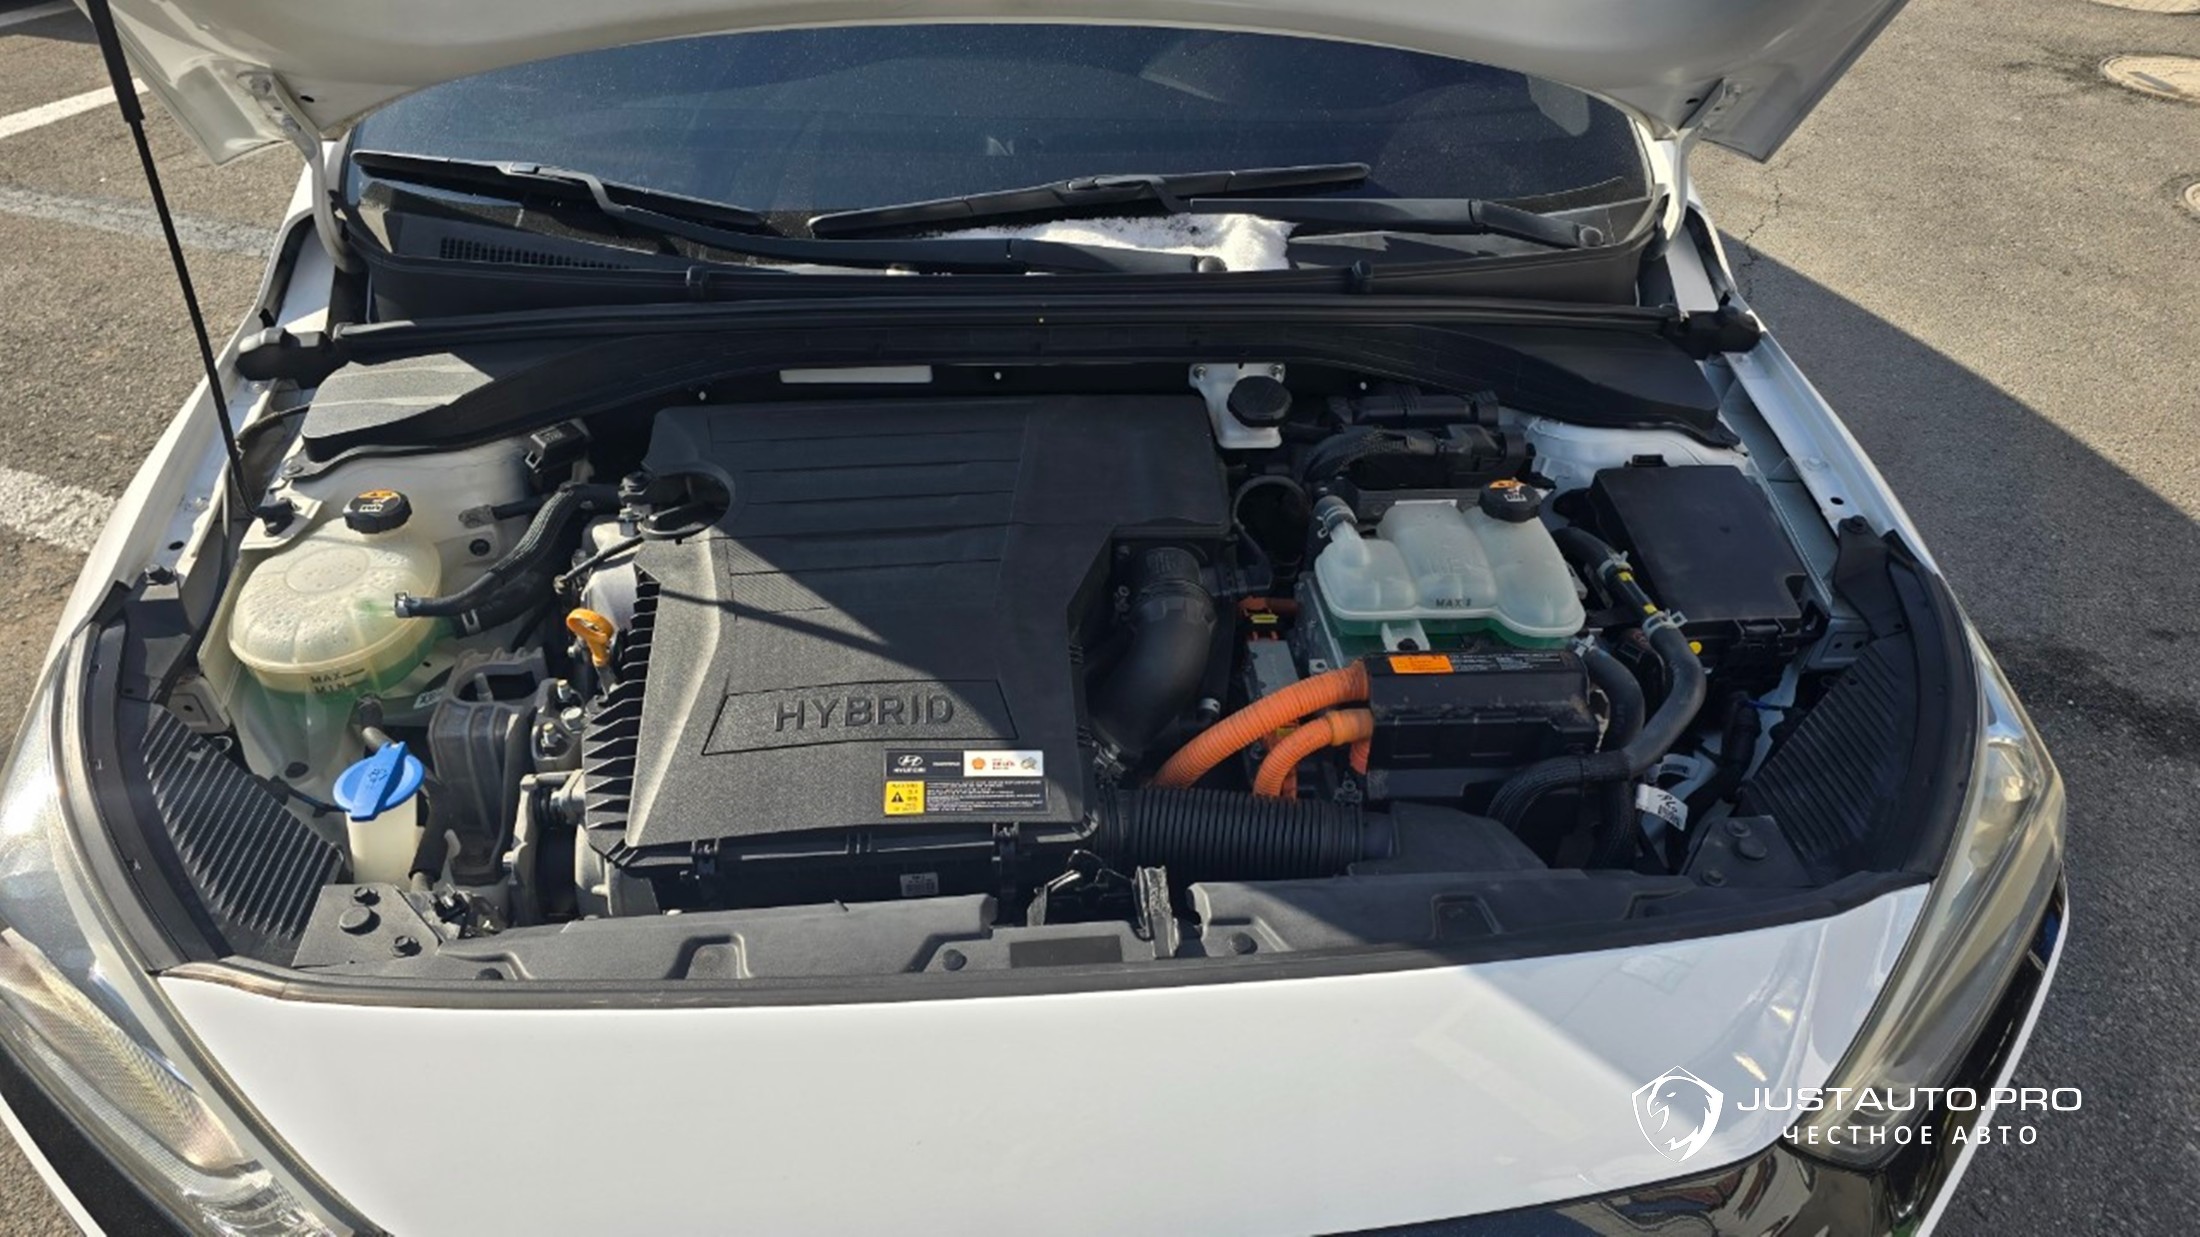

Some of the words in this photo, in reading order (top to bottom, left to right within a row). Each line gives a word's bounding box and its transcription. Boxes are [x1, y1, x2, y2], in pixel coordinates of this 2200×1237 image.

[1436, 598, 1463, 608] MAX
[310, 672, 341, 683] MAX
[314, 682, 346, 694] MIN
[775, 694, 954, 732] HYBRID
